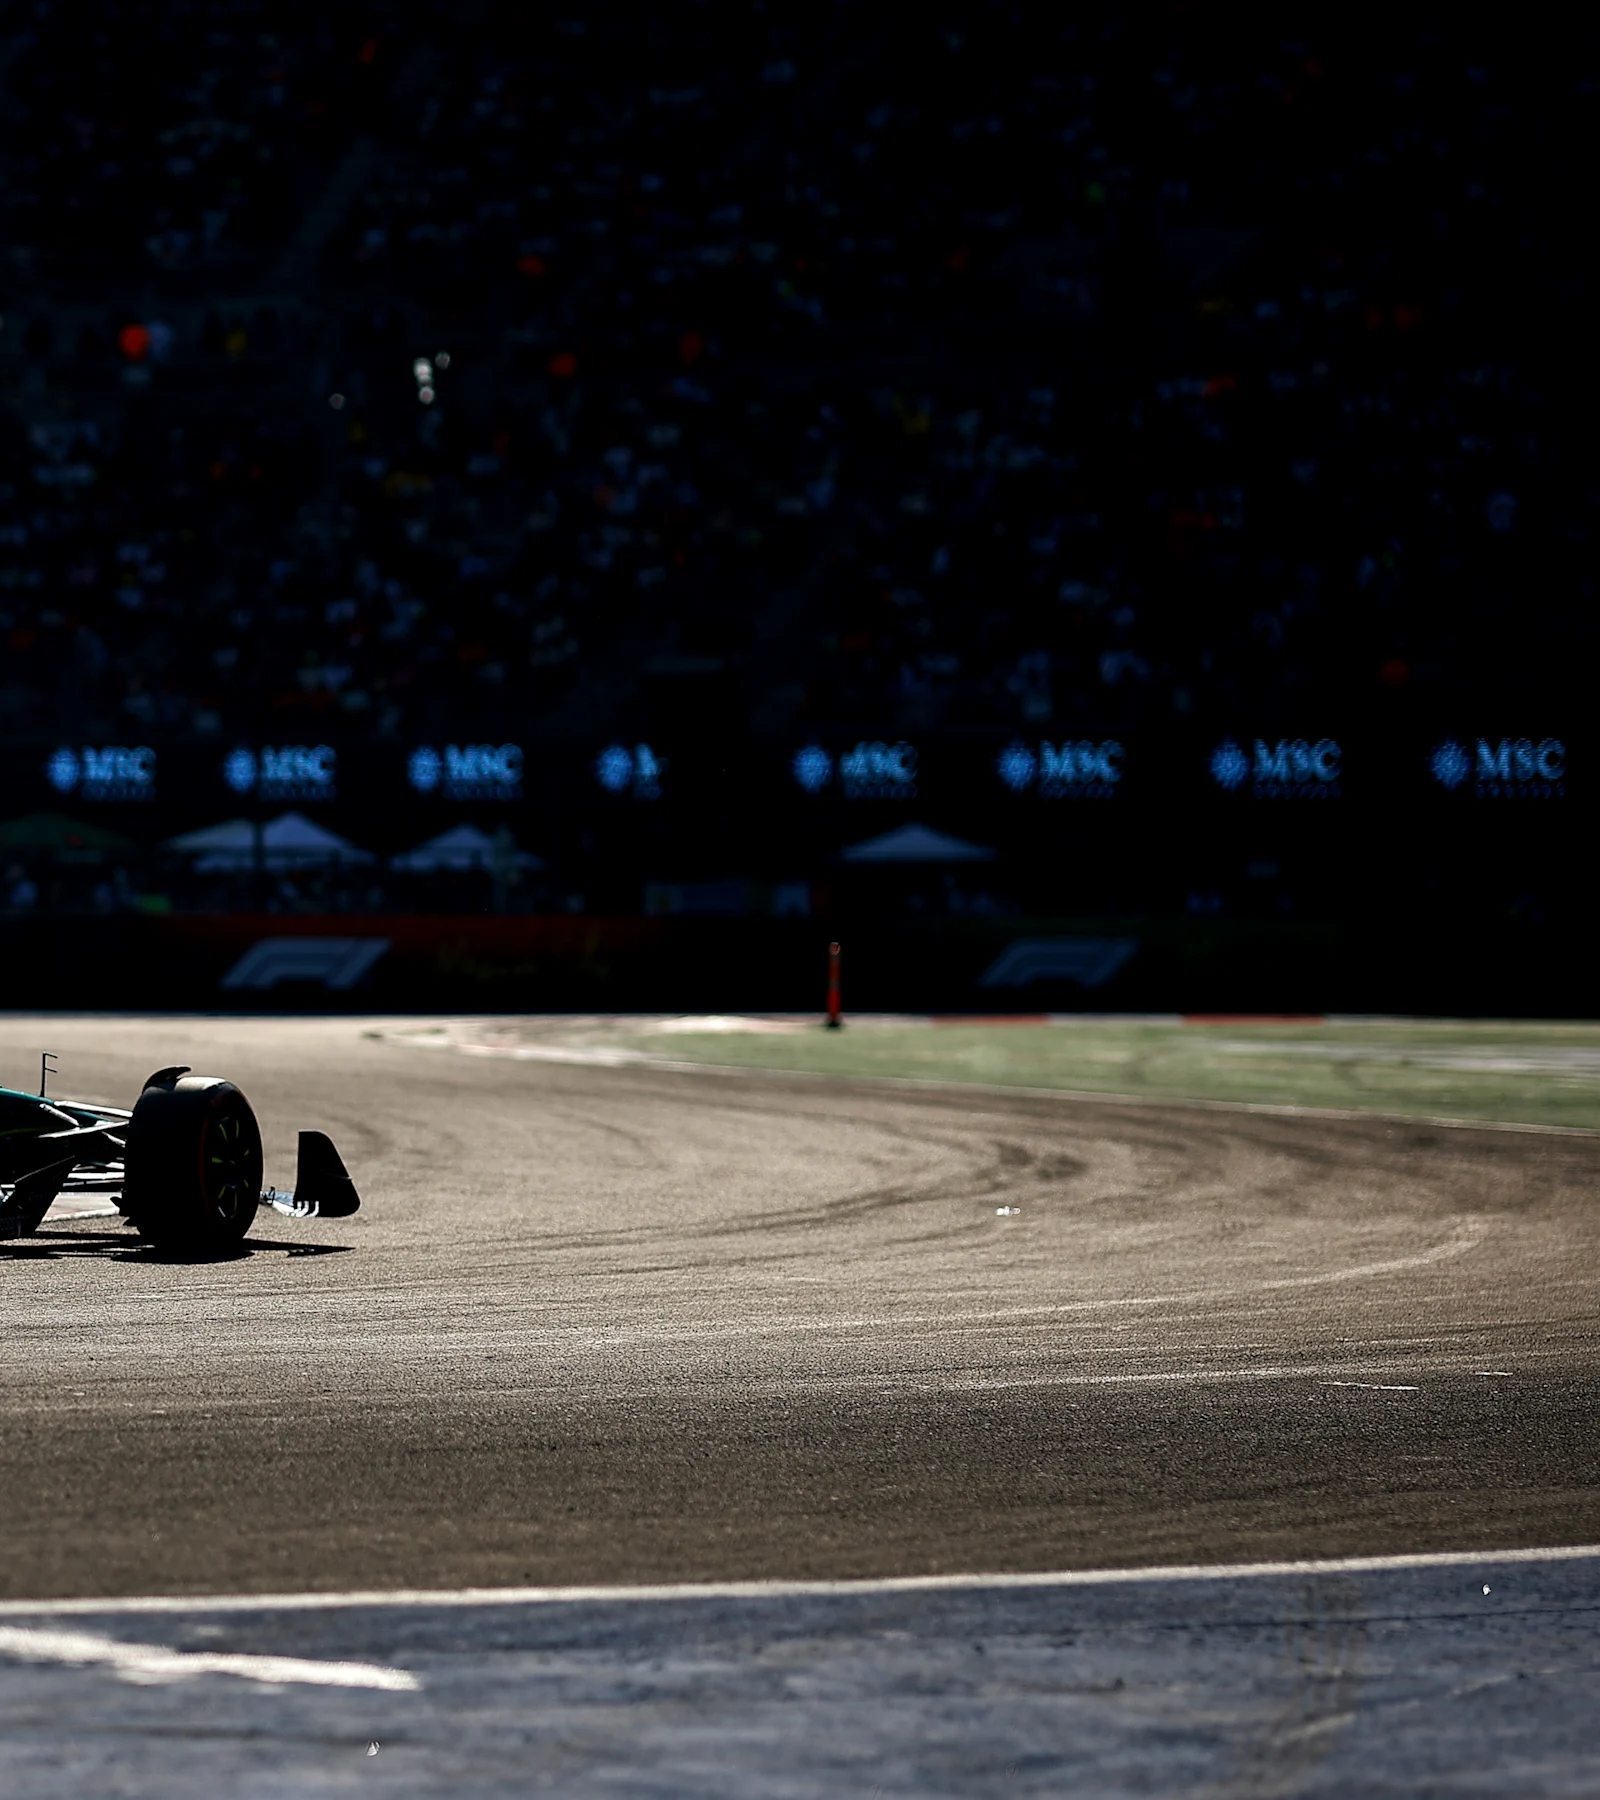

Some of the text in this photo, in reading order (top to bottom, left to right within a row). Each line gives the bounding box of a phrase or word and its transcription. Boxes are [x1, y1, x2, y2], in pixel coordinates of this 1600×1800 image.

[259, 744, 338, 785] MSC
[442, 743, 525, 784] MSC
[1037, 739, 1127, 783] MSC
[1252, 738, 1343, 783] MSC
[1475, 737, 1567, 782] MSC
